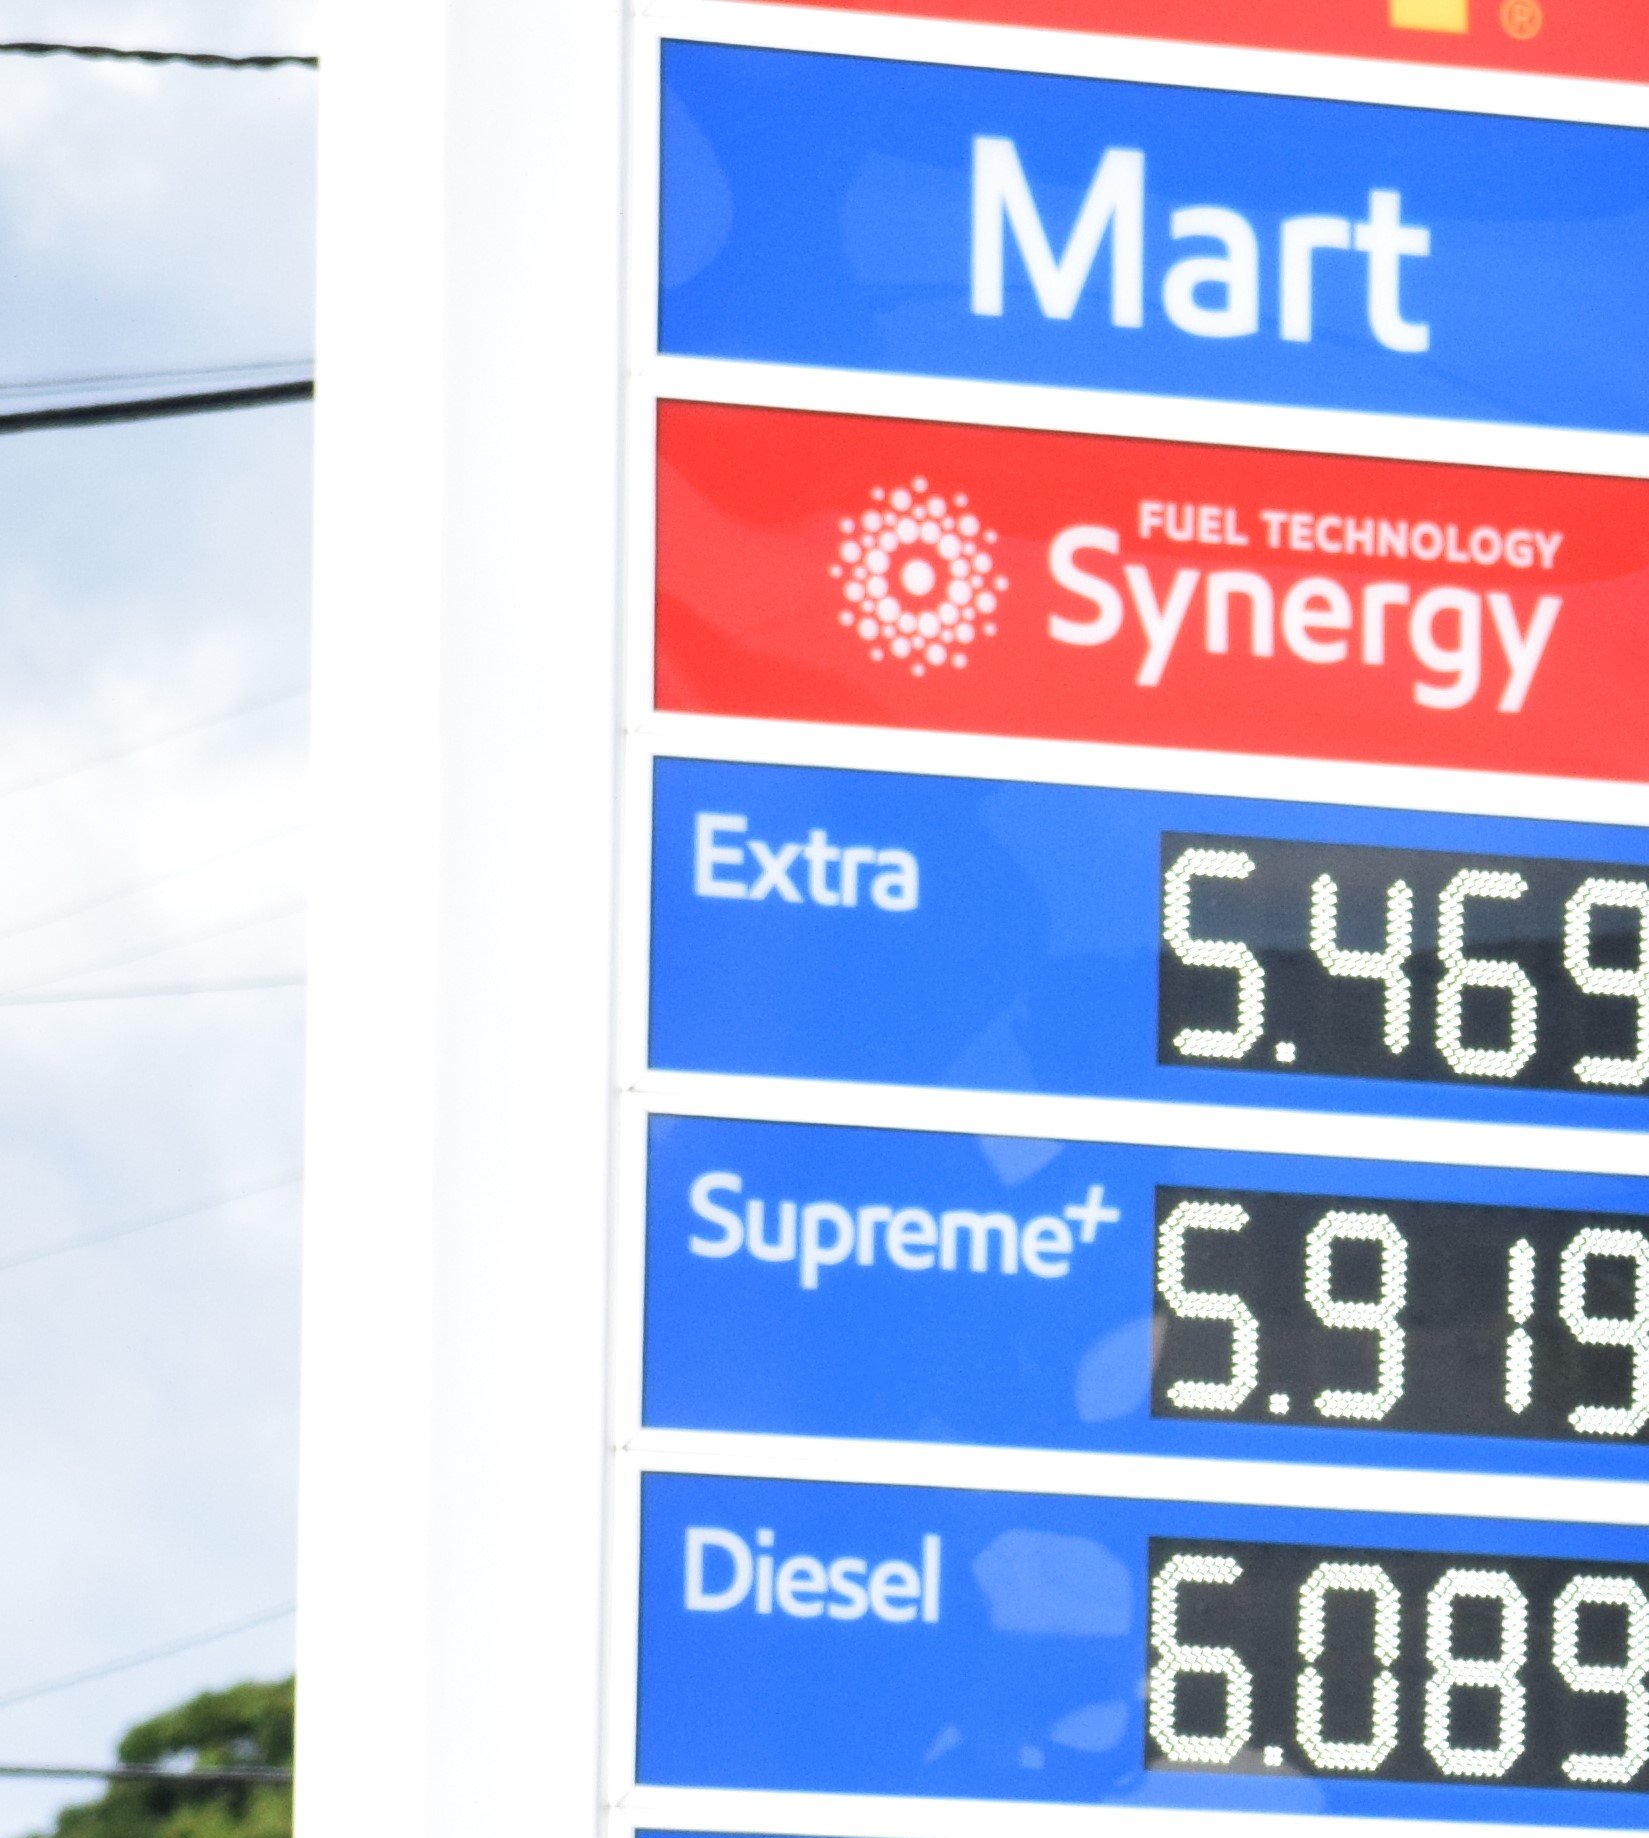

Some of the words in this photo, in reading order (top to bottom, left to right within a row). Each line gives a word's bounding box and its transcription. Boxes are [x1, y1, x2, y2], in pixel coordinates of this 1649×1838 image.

[970, 134, 1431, 354] Mart
[1138, 499, 1249, 547] FUEL
[1261, 508, 1564, 571] TECHNOLOGY
[1046, 525, 1563, 713] Synergy
[692, 812, 920, 912] Extra
[683, 1525, 941, 1624] Diesel
